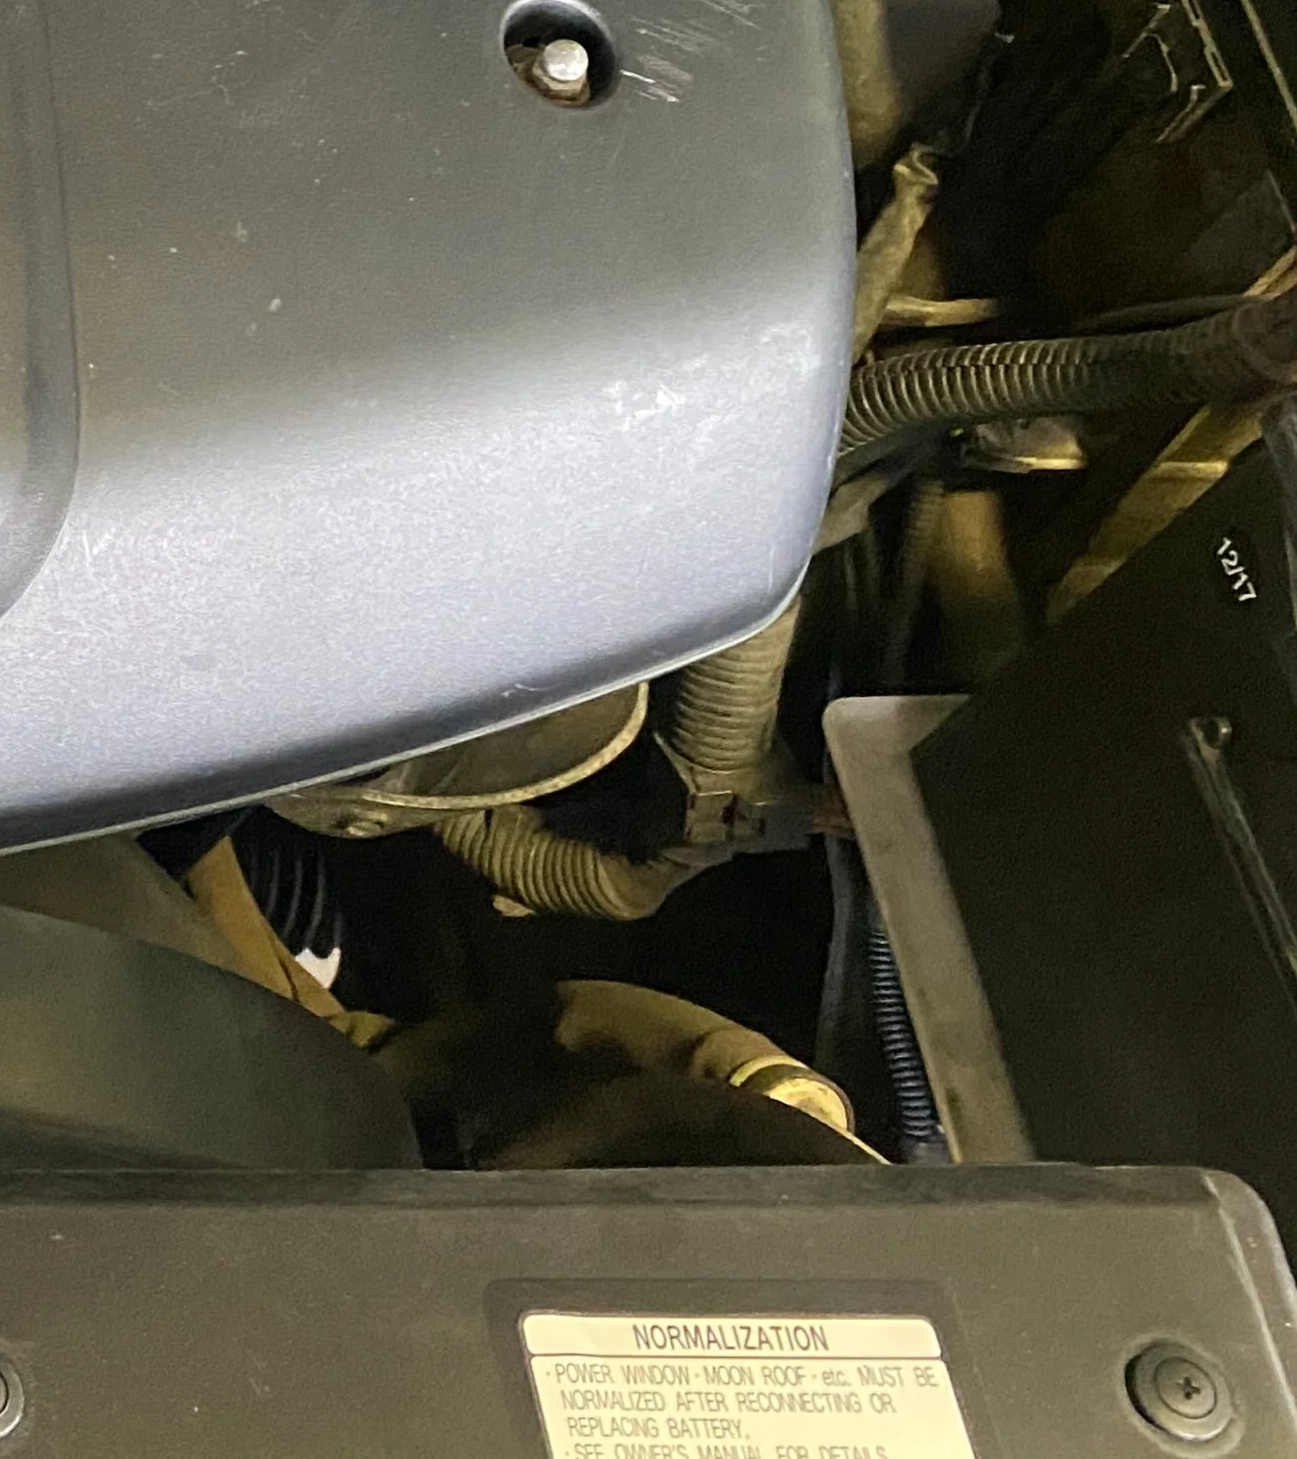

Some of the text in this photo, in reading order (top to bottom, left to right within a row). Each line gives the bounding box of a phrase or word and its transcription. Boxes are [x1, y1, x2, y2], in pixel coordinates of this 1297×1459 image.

[1217, 537, 1257, 601] 12/17
[632, 1324, 829, 1351] NORMALIZATION
[555, 1362, 939, 1388] POWER WINDOW MOON ROOF etc. MUST BE
[560, 1390, 896, 1414] NORMALIZED AFTER RECONNECTING OR
[566, 1417, 750, 1440] REPLACING BATTERY.
[574, 1443, 604, 1459] SEE
[615, 1443, 689, 1459] OWNER'S
[697, 1444, 761, 1459] MANUAL
